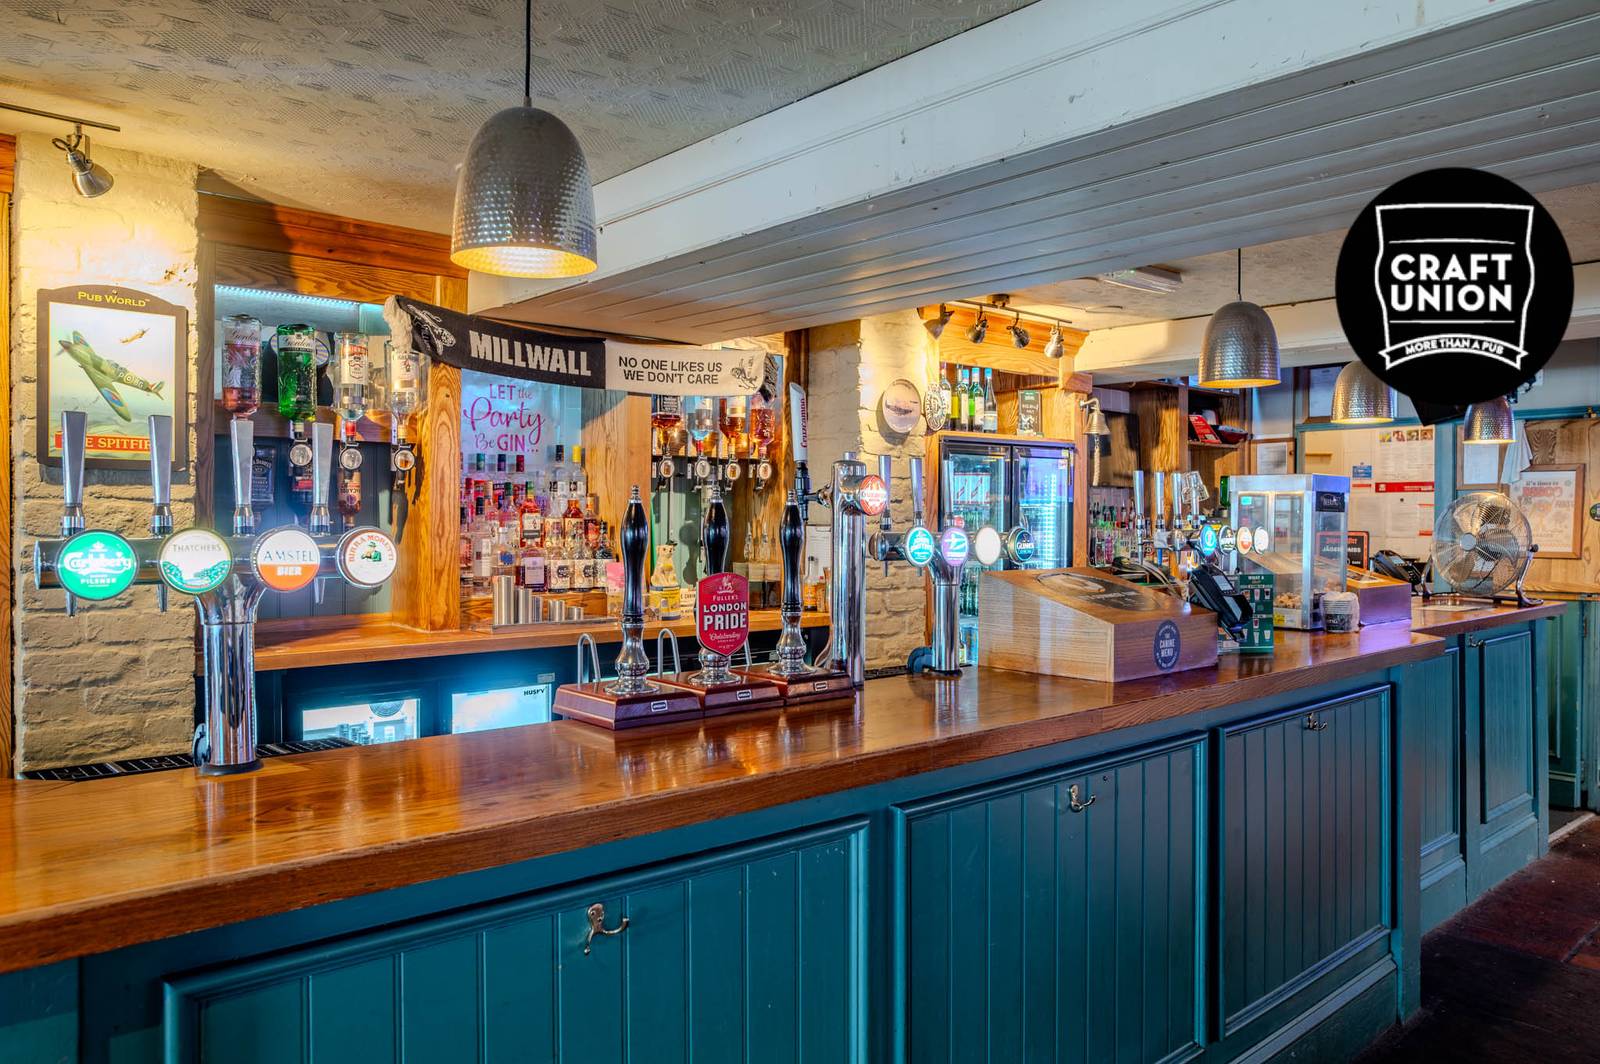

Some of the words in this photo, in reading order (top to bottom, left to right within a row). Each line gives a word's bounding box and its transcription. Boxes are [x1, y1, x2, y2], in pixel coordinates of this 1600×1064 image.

[78, 291, 102, 302] PUB
[105, 294, 146, 307] WORLD
[469, 330, 591, 376] MILLWALL
[619, 356, 637, 368] NO
[641, 359, 669, 371] ONE
[670, 360, 704, 372] LIKES
[707, 361, 722, 373] US
[623, 369, 645, 381] WE
[647, 371, 683, 384] DON'T
[686, 373, 719, 385] CARE
[490, 384, 516, 400] LET
[518, 388, 533, 400] the
[463, 397, 546, 445] Party
[97, 438, 151, 451] SPITFI
[475, 433, 495, 450] Be
[173, 544, 222, 552] THATCHERS
[264, 550, 314, 562] AMSTEL
[64, 552, 132, 575] Carlsberg
[277, 566, 302, 577] BIER
[703, 602, 747, 613] LONDON
[703, 613, 747, 631] PRIDE
